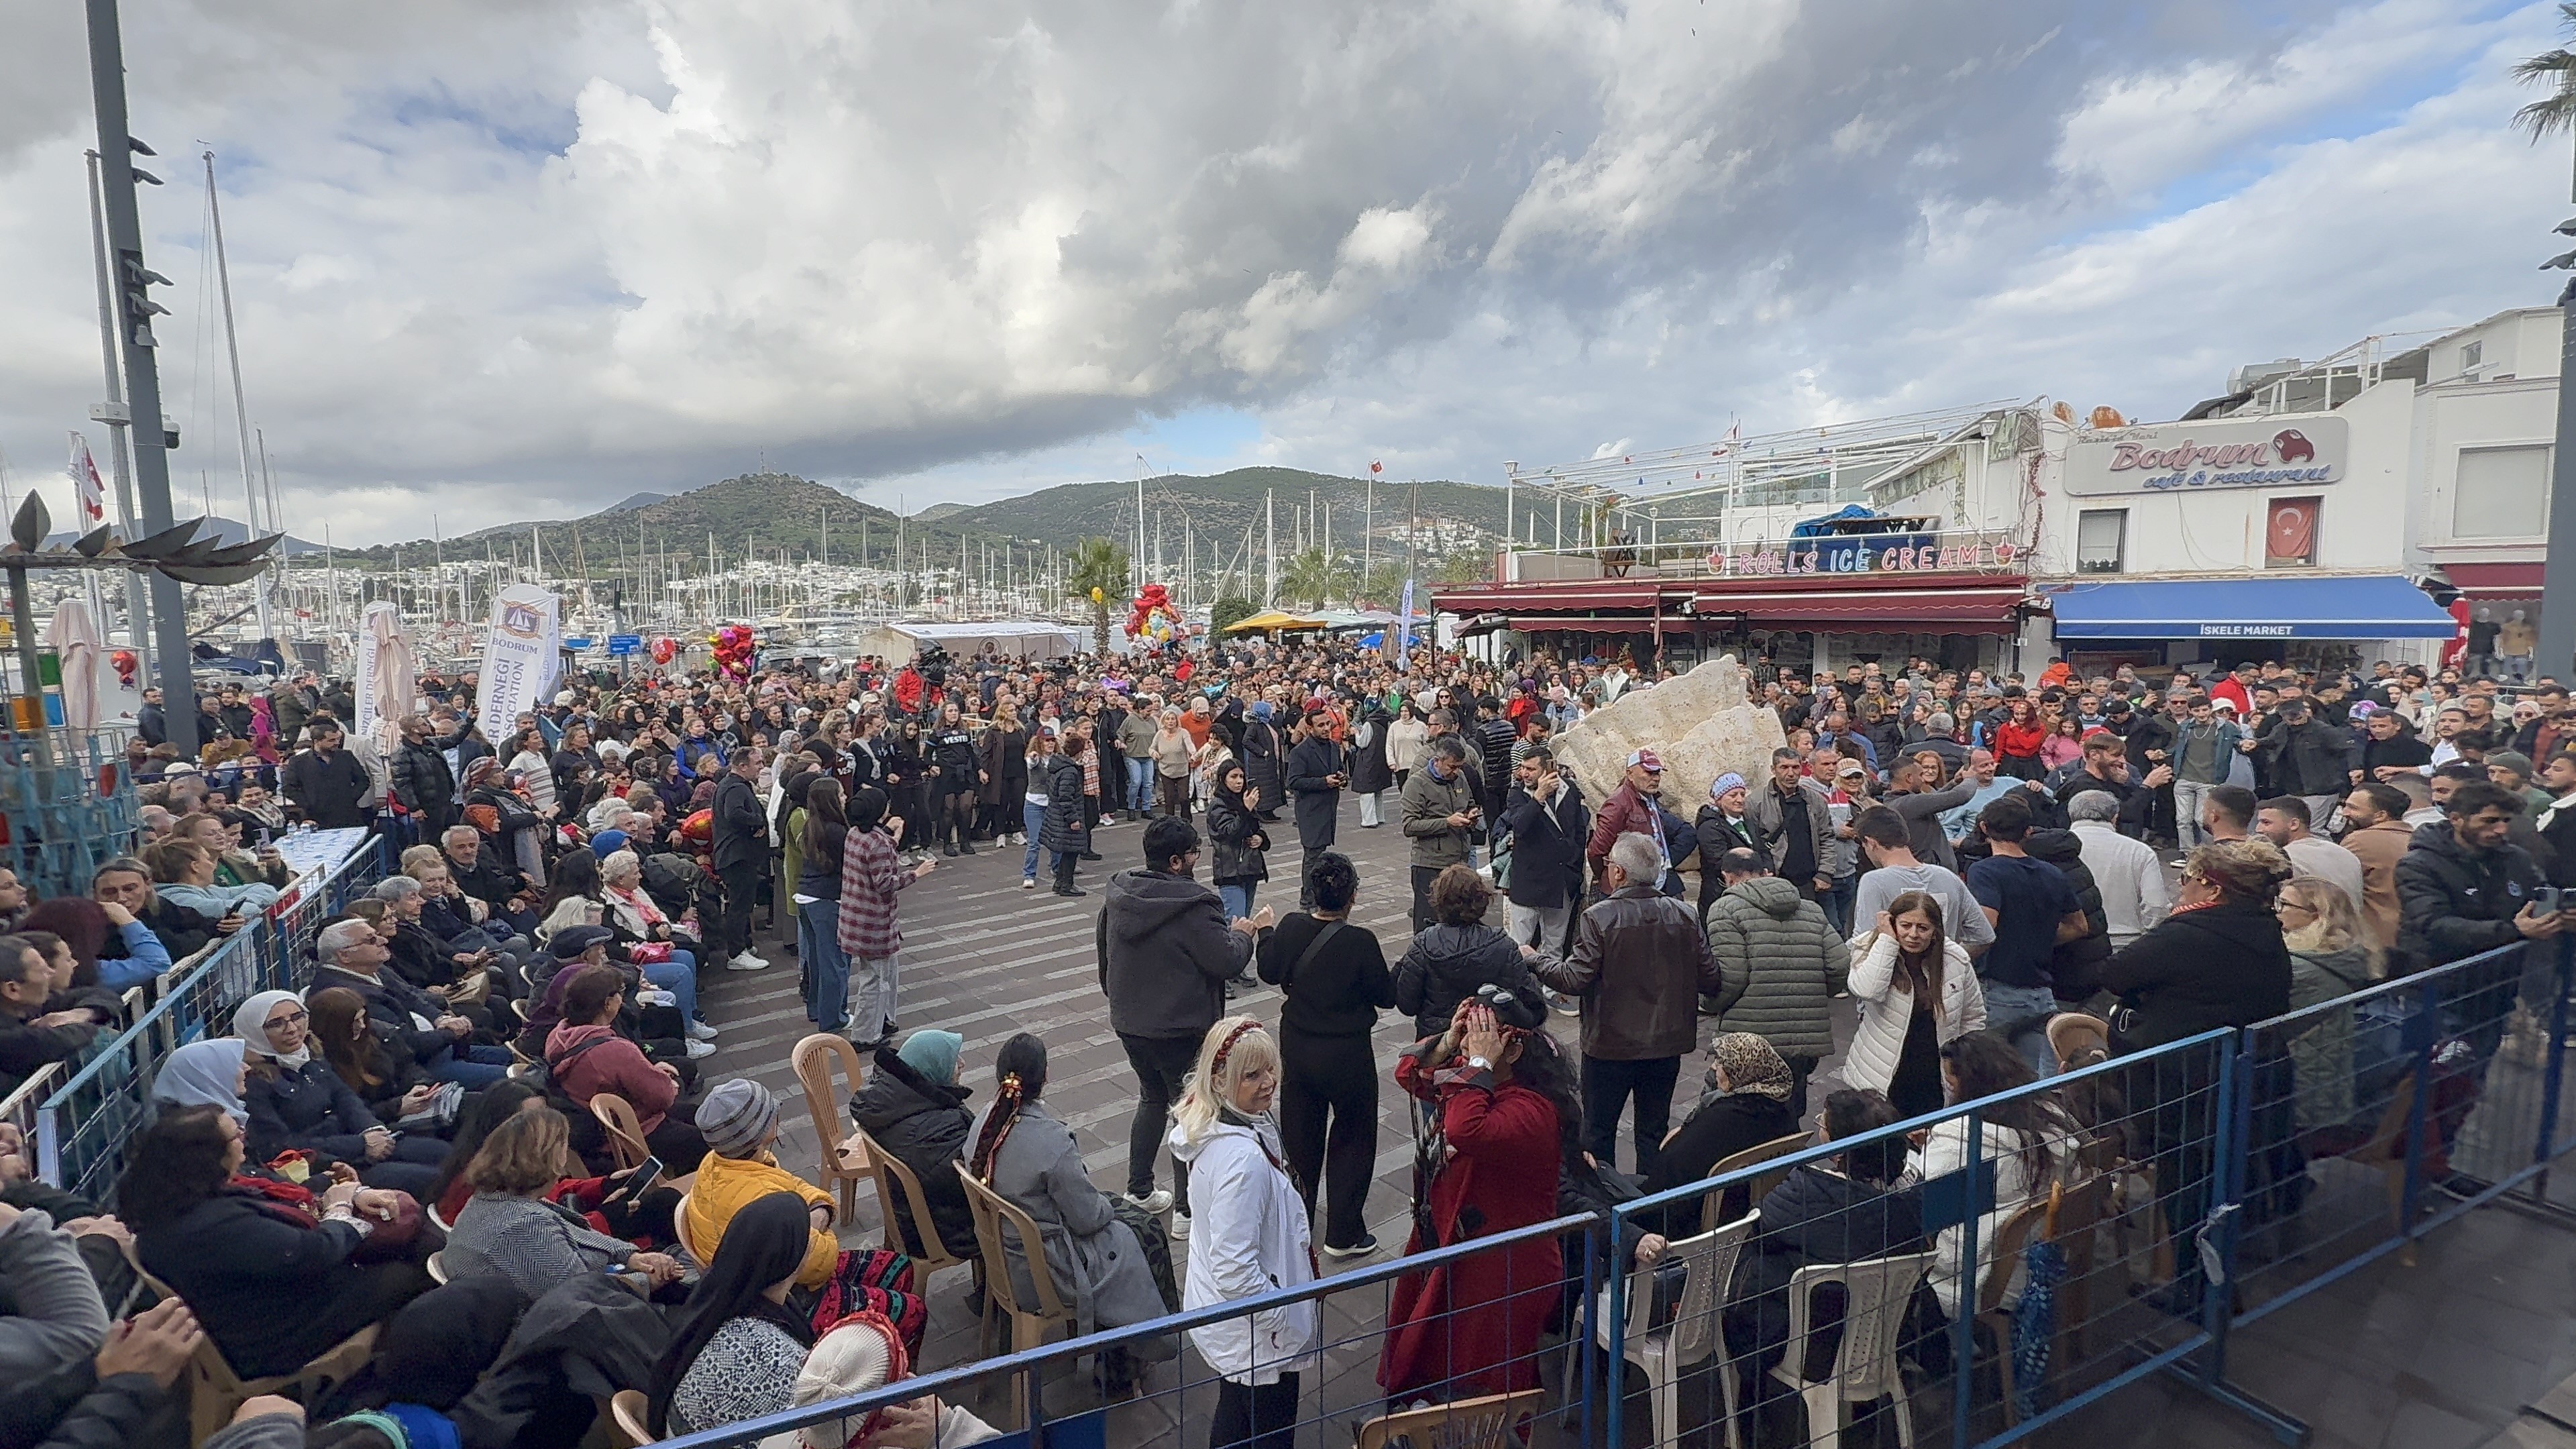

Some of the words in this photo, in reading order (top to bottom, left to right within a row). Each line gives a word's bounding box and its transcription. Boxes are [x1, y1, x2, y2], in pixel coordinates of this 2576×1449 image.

[2109, 439, 2269, 472] Bodrum
[2188, 470, 2206, 486] &
[2208, 464, 2332, 484] restaurant
[1738, 551, 1818, 574] ROLLS
[1830, 548, 1872, 572] ICE
[1881, 544, 1980, 571] CREAM
[2200, 624, 2242, 635] İSKELE
[2243, 625, 2294, 635] MARKET
[492, 637, 538, 655] BODRUM
[489, 657, 510, 724] DERNEĞİ
[503, 660, 525, 739] SSOCIATION
[360, 692, 374, 736] NİZCİLER
